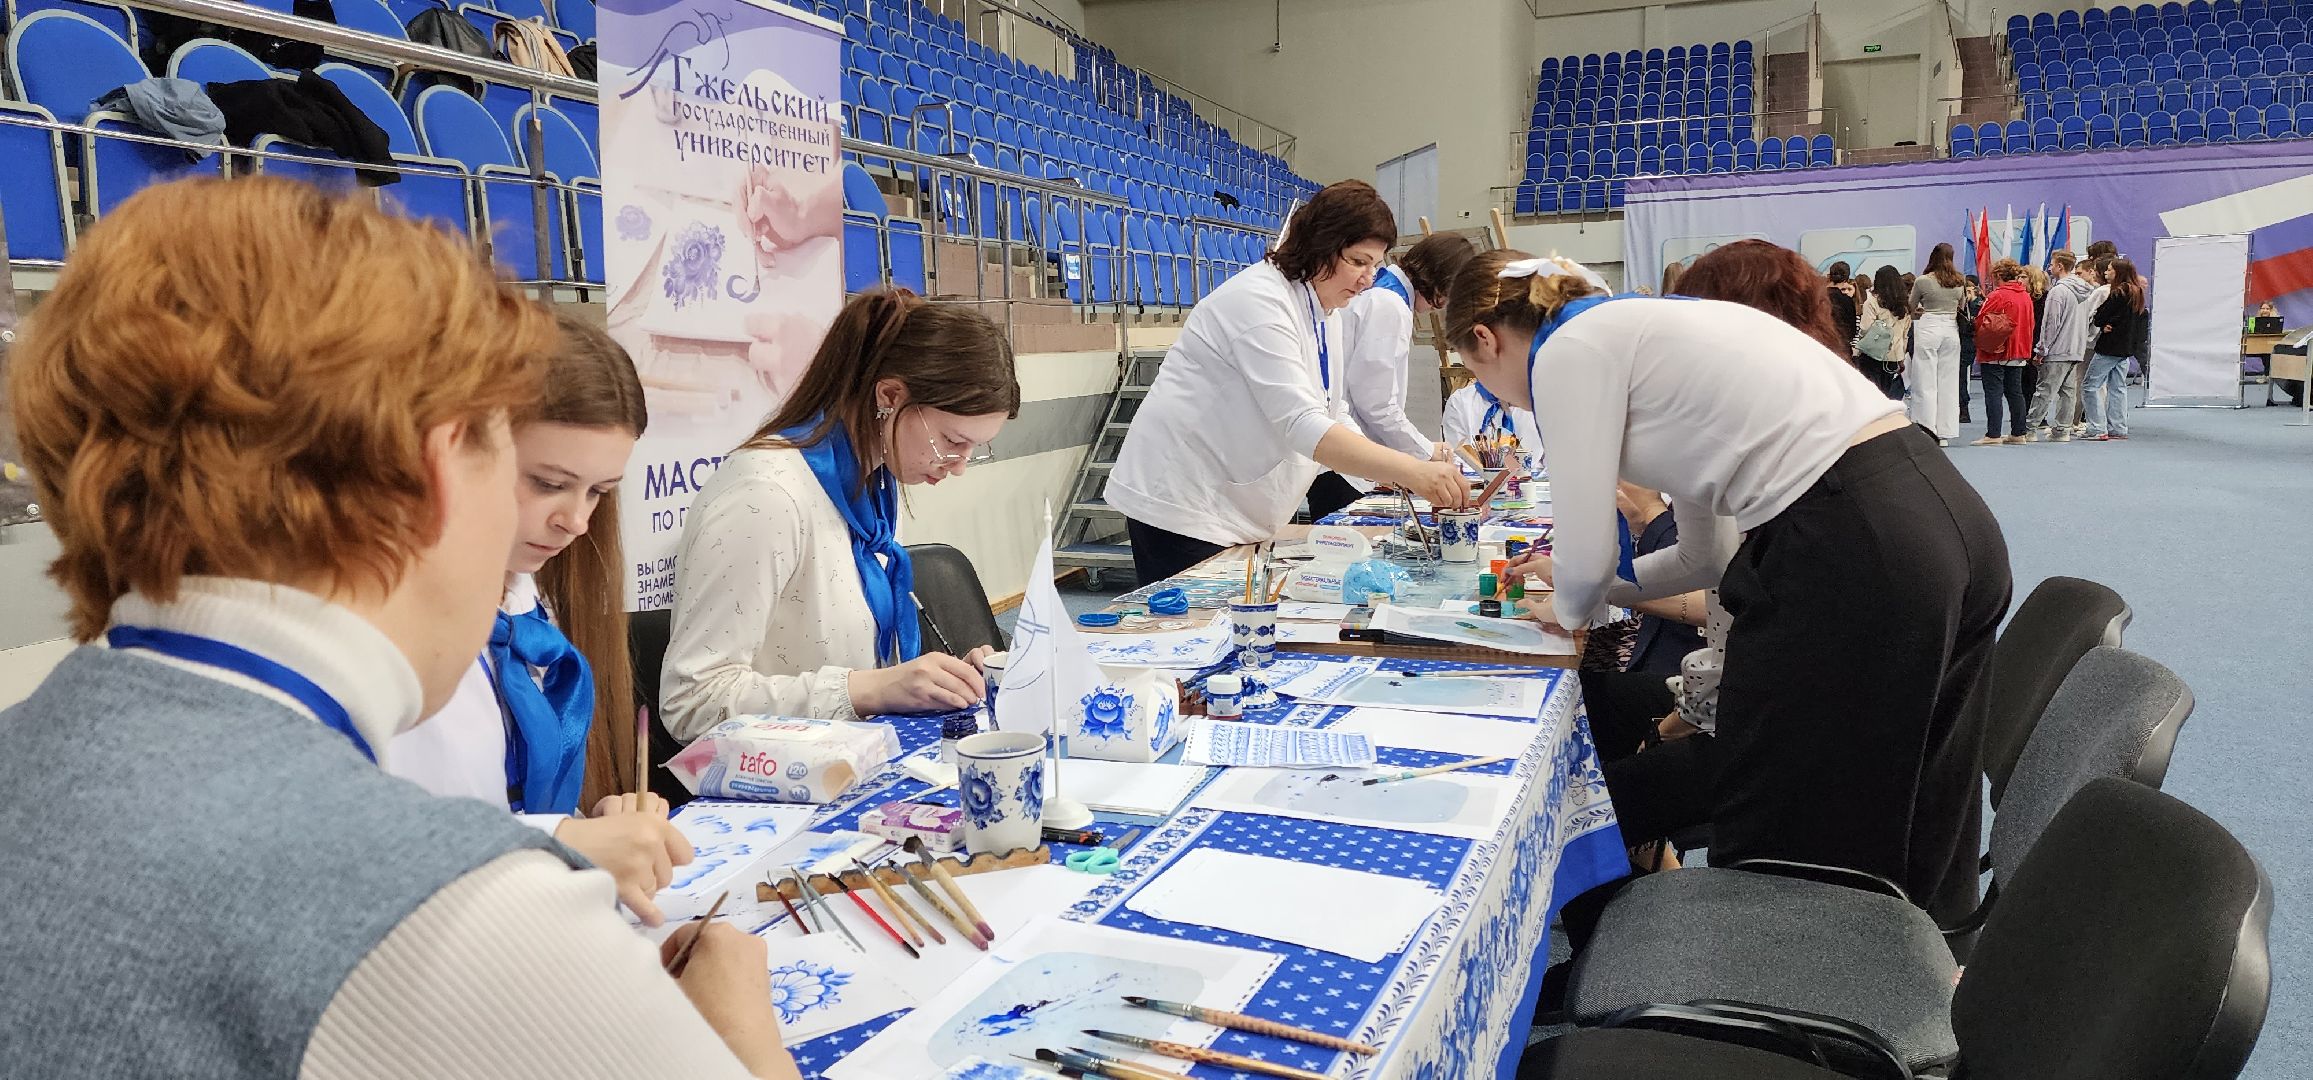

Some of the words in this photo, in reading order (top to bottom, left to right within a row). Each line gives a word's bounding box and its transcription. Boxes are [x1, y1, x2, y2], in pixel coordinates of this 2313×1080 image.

[644, 455, 729, 500] МАСТ
[652, 509, 674, 533] ПО
[637, 560, 654, 577] ВЫ
[637, 572, 676, 594] ЗНАМЕ
[739, 751, 777, 776] tafo
